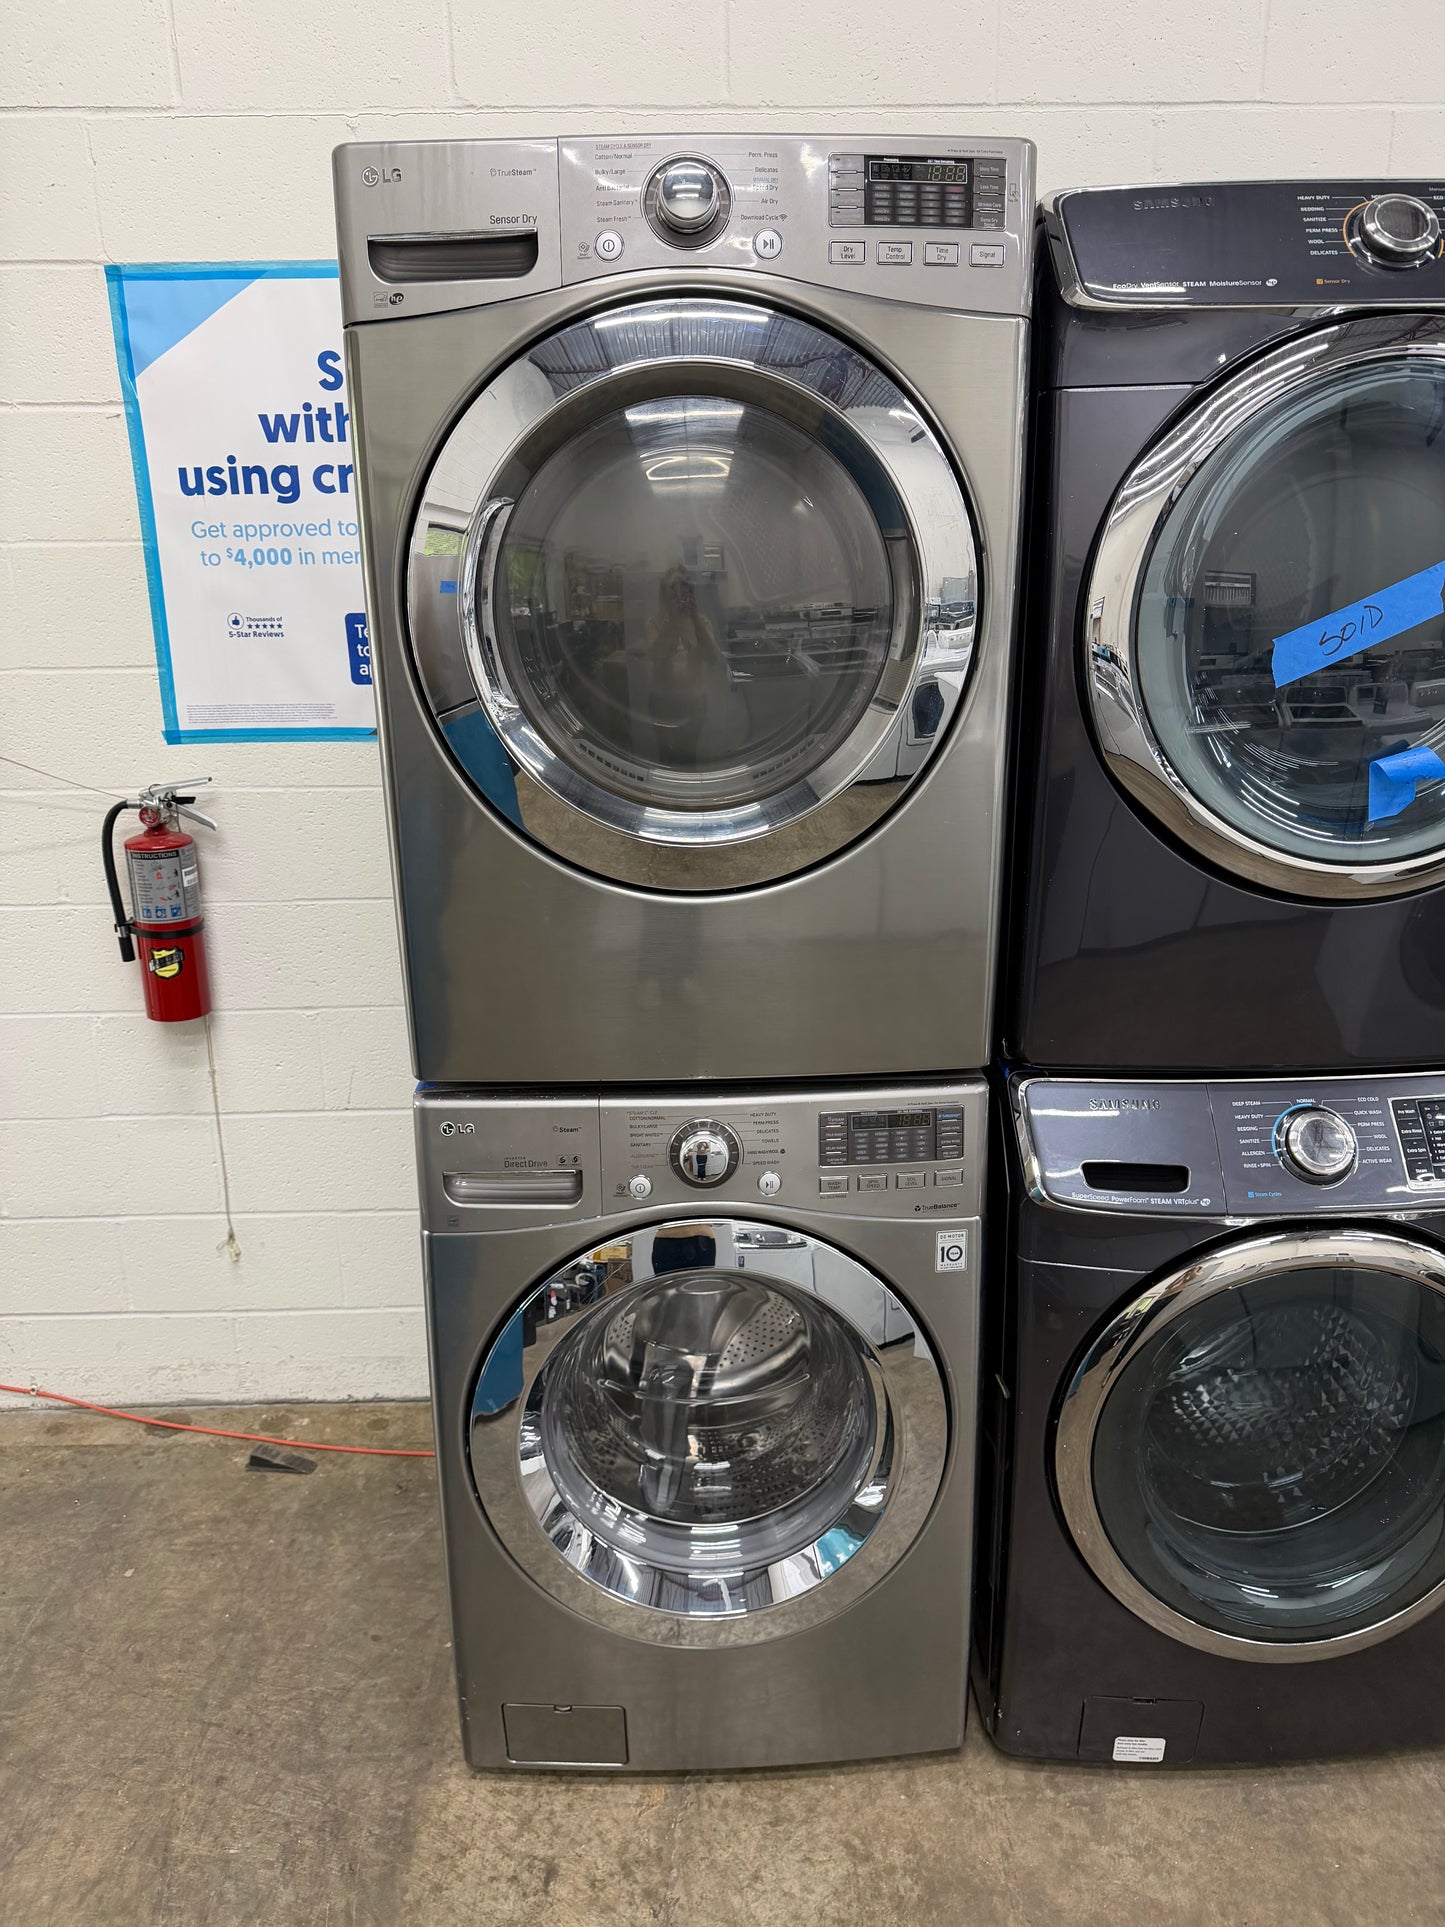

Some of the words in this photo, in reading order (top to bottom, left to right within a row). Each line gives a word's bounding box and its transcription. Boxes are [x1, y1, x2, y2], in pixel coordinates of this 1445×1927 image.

[382, 168, 402, 183] LG
[1134, 196, 1214, 210] SAMSUNG
[489, 215, 519, 225] Sensor
[522, 214, 538, 225] Dry
[178, 454, 301, 504] using
[191, 521, 227, 538] Get
[233, 519, 331, 542] approved
[337, 521, 358, 536] to
[200, 551, 221, 566] to
[226, 547, 292, 569] $4,000
[298, 548, 316, 565] in
[1089, 1099, 1160, 1110] SAMSUNG
[457, 1123, 475, 1134] LG
[1072, 1192, 1109, 1201] SuperSpeed
[941, 1245, 963, 1262] 10
